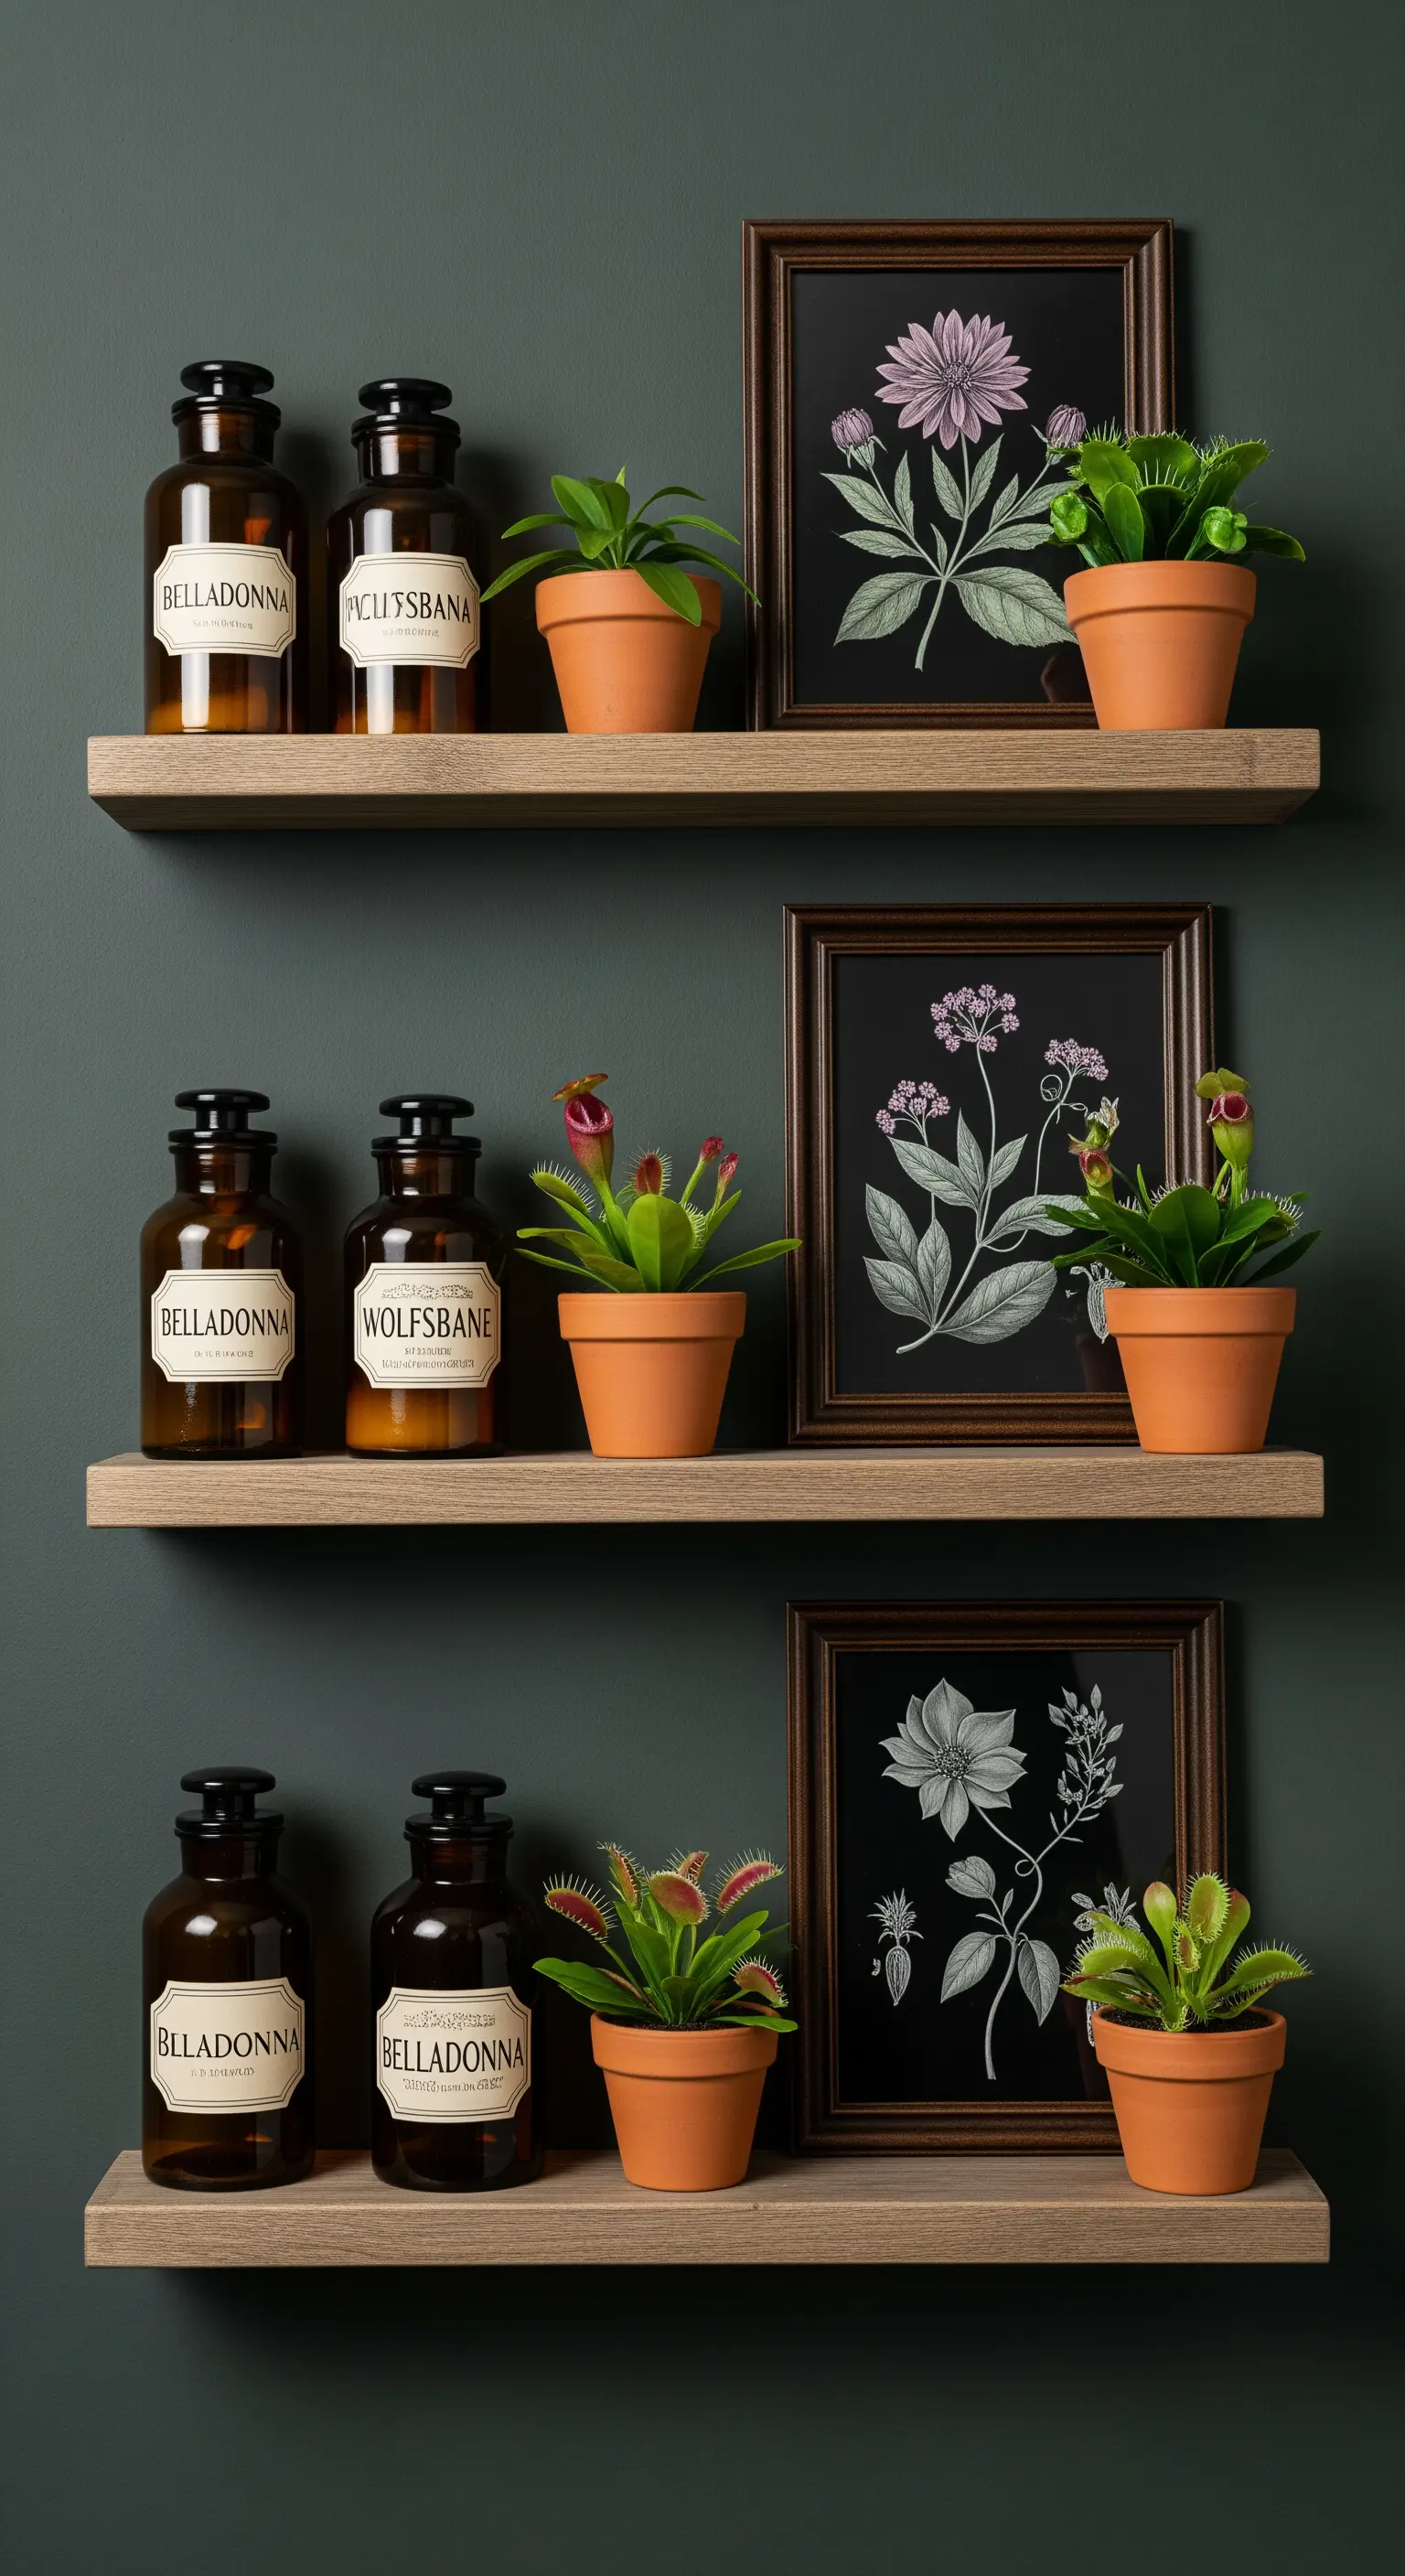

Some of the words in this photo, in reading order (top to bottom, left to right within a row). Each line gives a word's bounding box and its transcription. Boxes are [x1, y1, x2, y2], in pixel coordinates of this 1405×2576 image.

[163, 582, 289, 613] BELLADONNA
[161, 1307, 289, 1336] BELLADONNA
[362, 1306, 492, 1338] WOLFSBANE
[382, 2035, 524, 2074] BELLADONNA
